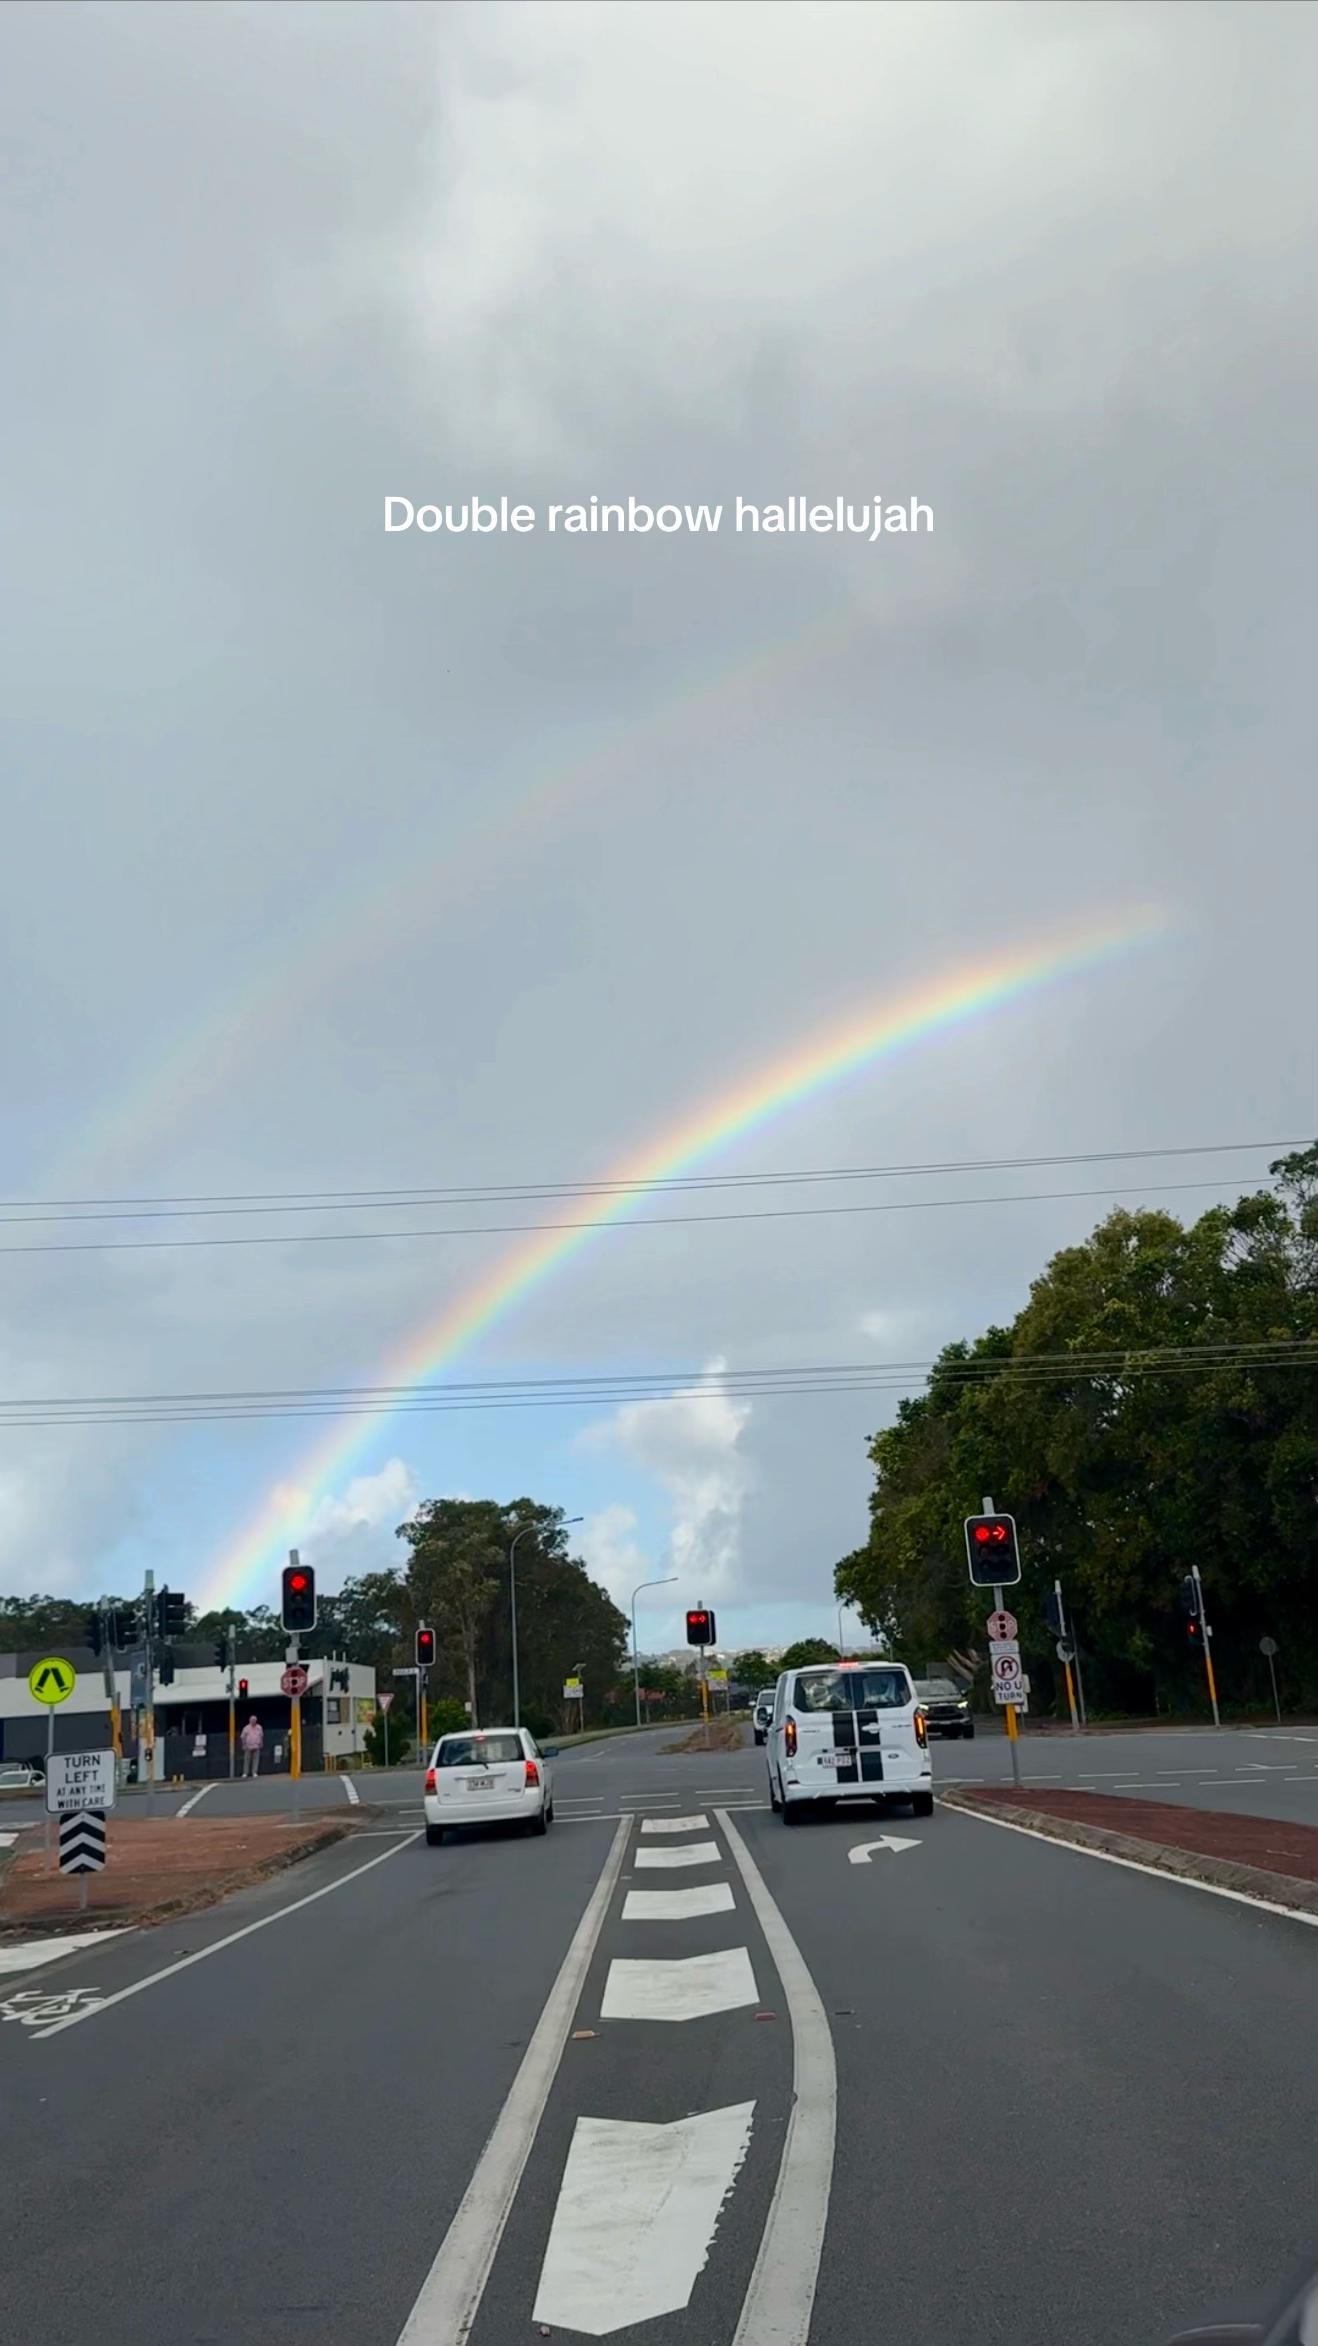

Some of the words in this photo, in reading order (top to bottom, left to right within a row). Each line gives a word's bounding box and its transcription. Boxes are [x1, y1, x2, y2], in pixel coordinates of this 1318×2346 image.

[996, 1682, 1012, 1691] NO
[1015, 1682, 1022, 1690] U
[998, 1692, 1022, 1700] TURN
[64, 1755, 101, 1768] TURN
[65, 1770, 99, 1784] LEFT
[57, 1787, 66, 1796] AT
[69, 1786, 86, 1796] ANY
[90, 1784, 105, 1793] TIME
[57, 1799, 80, 1809] WITH
[81, 1796, 105, 1807] CARE
